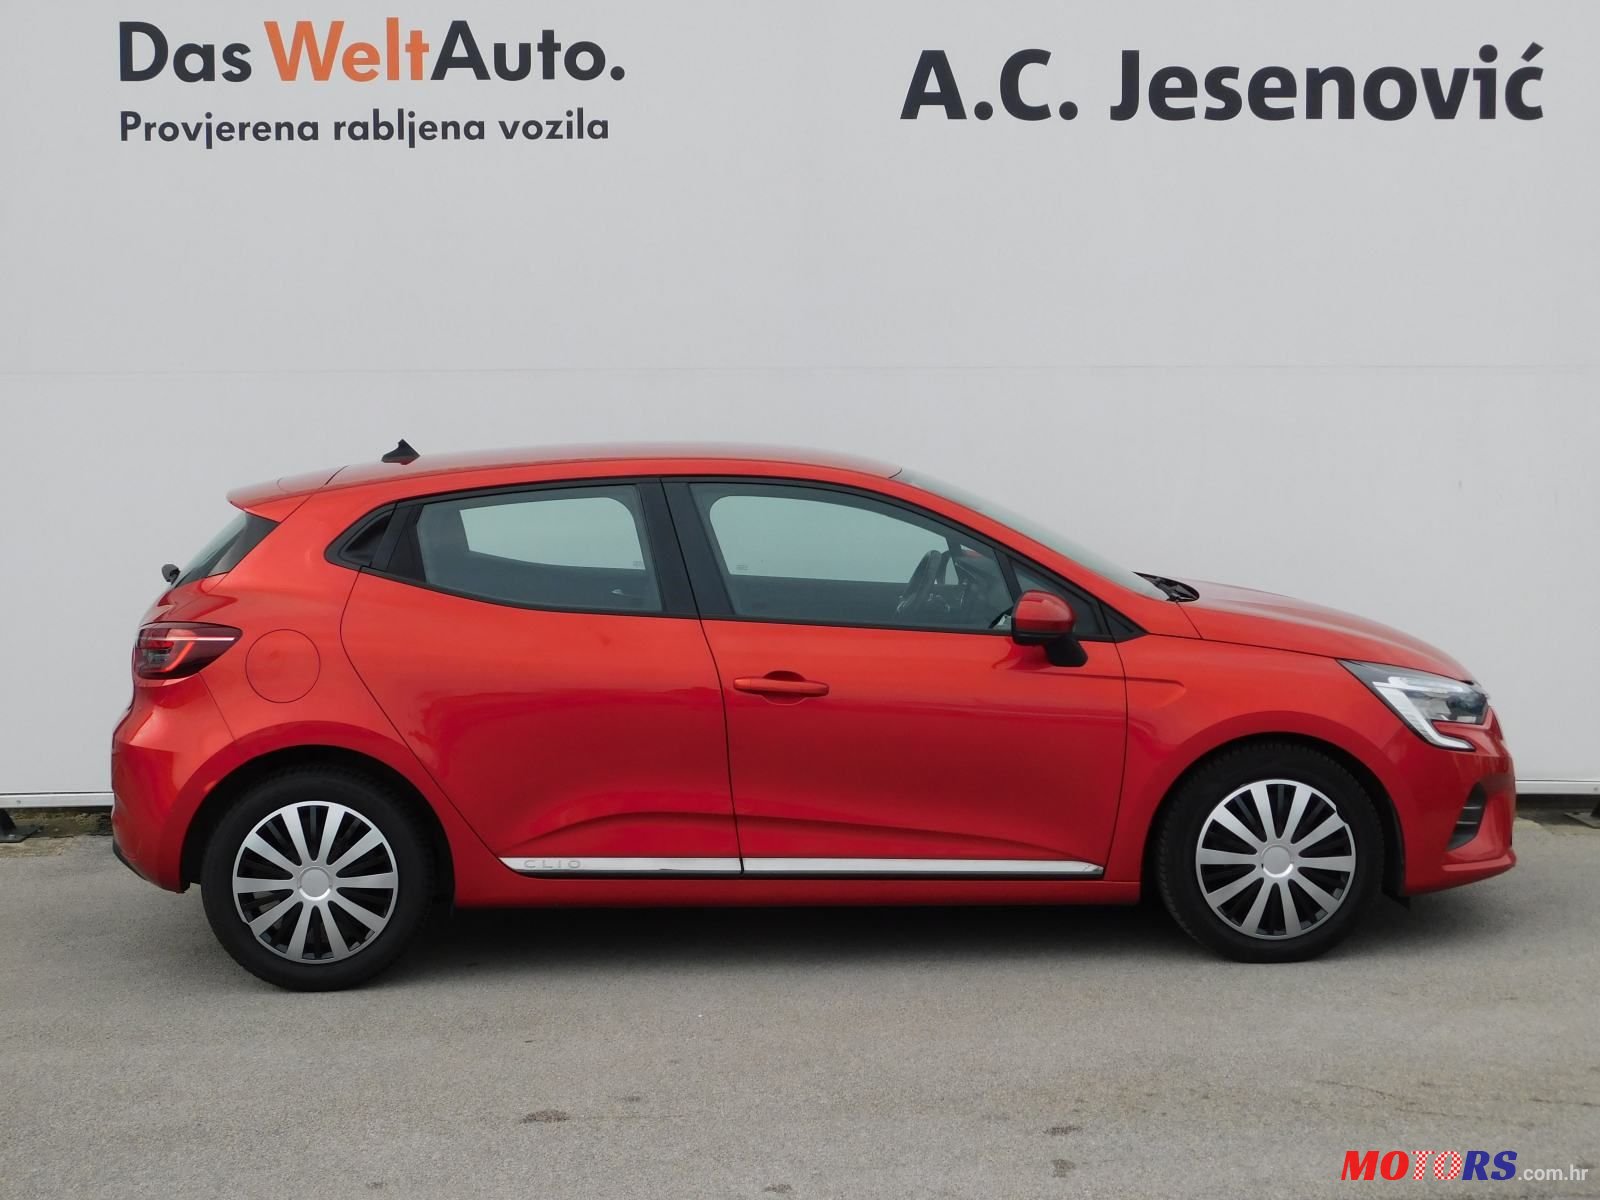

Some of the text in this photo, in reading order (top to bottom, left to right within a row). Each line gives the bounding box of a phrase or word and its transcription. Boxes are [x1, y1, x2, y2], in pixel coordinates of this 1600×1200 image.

[119, 17, 625, 82] Das WeltAuto.
[900, 42, 1544, 121] A.C. Jesenović
[121, 107, 608, 149] Provjerena rabljena vozila
[524, 859, 581, 869] CLIO
